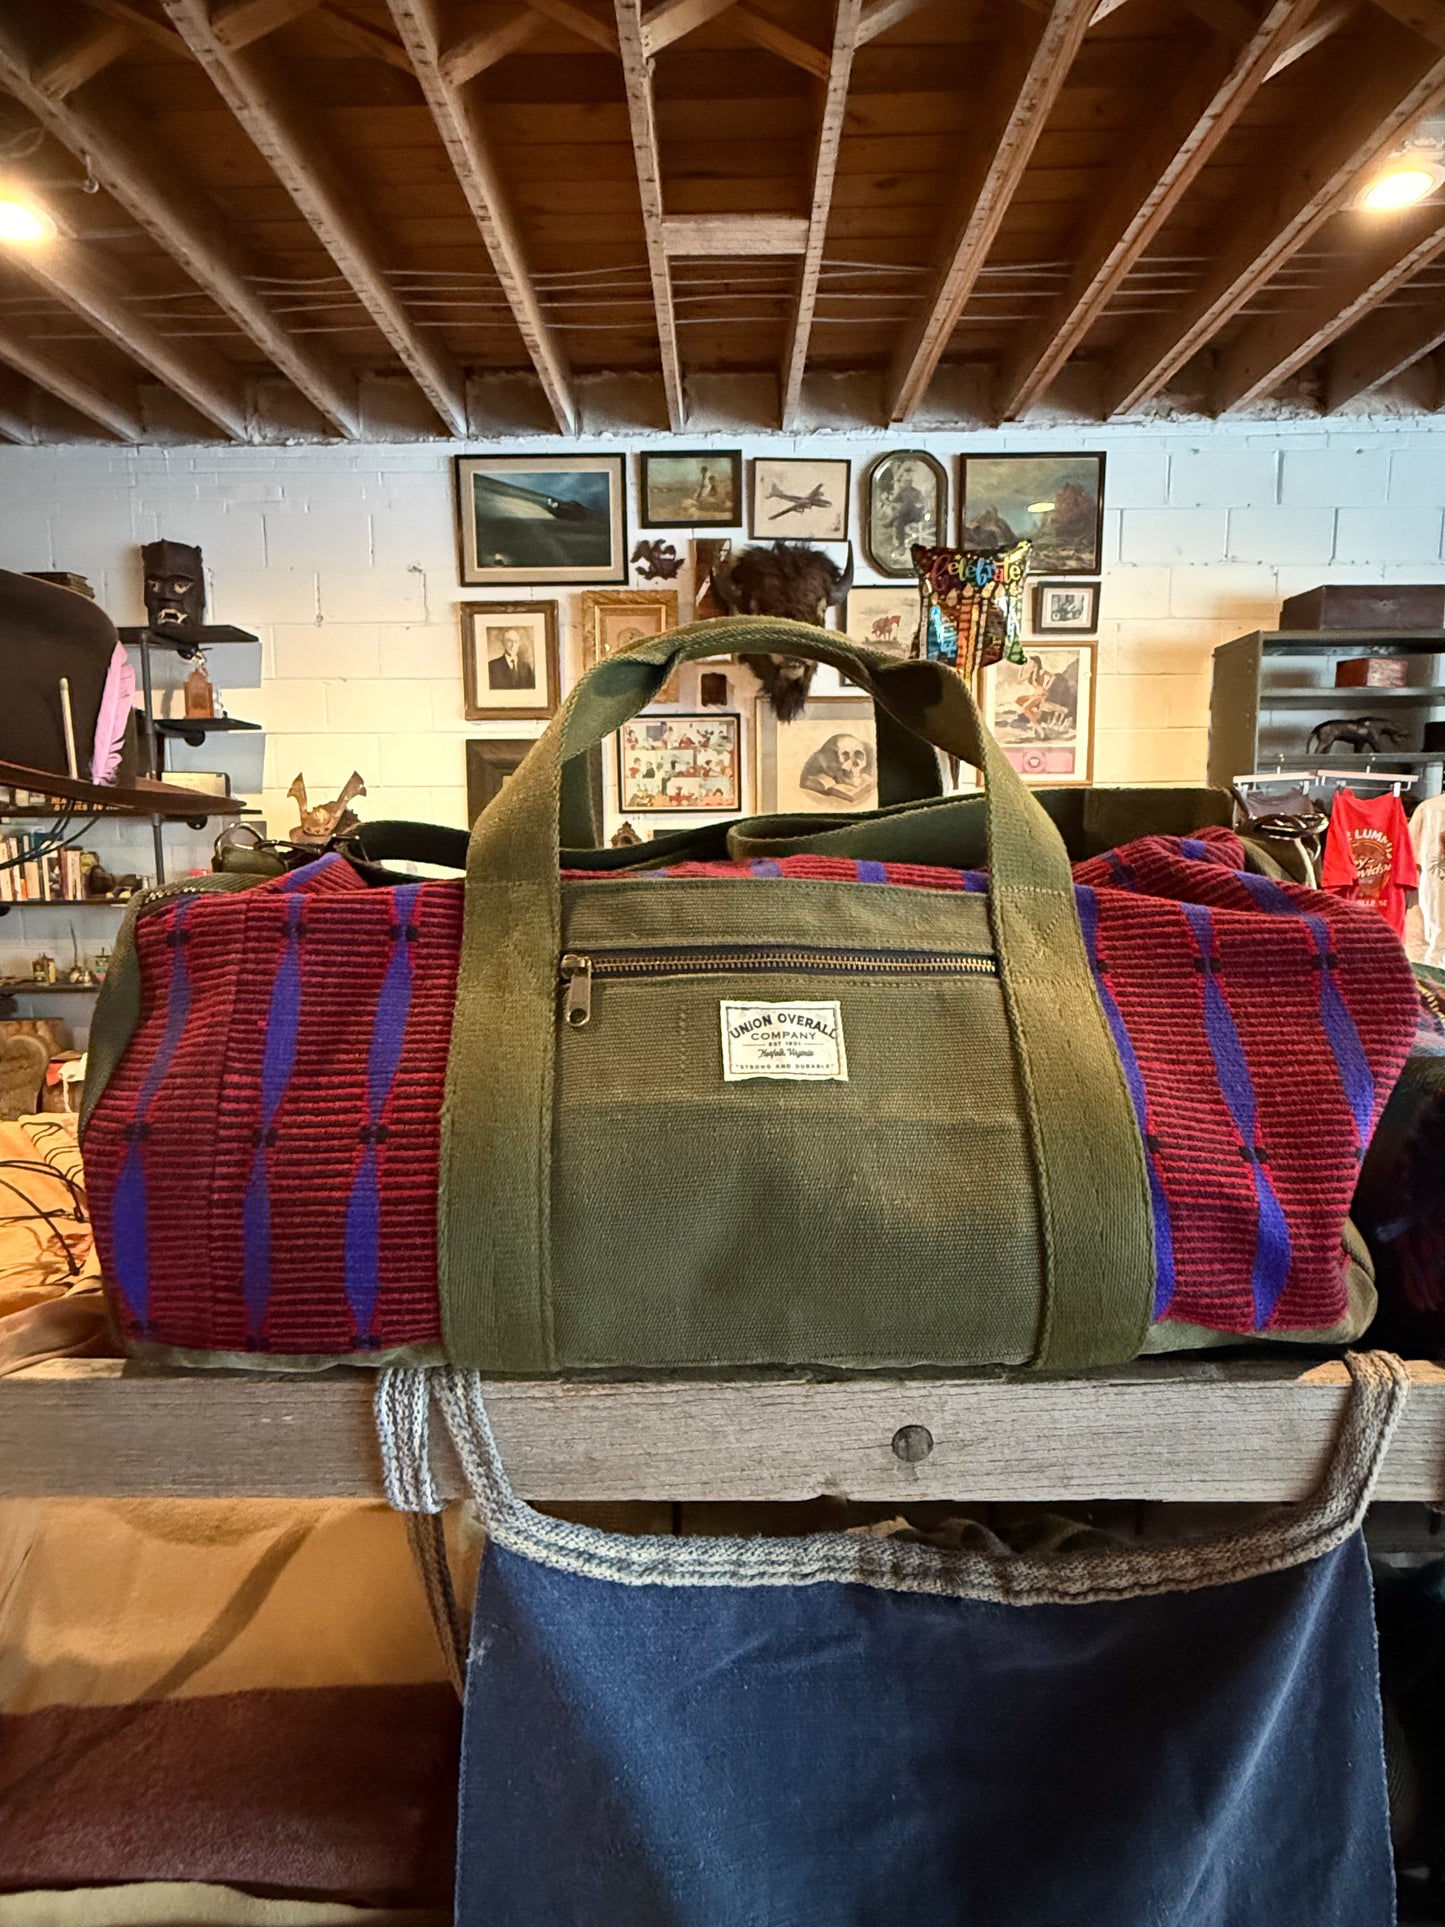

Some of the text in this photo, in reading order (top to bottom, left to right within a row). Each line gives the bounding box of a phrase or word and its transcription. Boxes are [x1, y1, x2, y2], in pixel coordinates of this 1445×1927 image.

[930, 554, 1021, 591] Celebrate
[729, 1013, 838, 1040] UNION OVERALL
[750, 1031, 816, 1040] COMPANY
